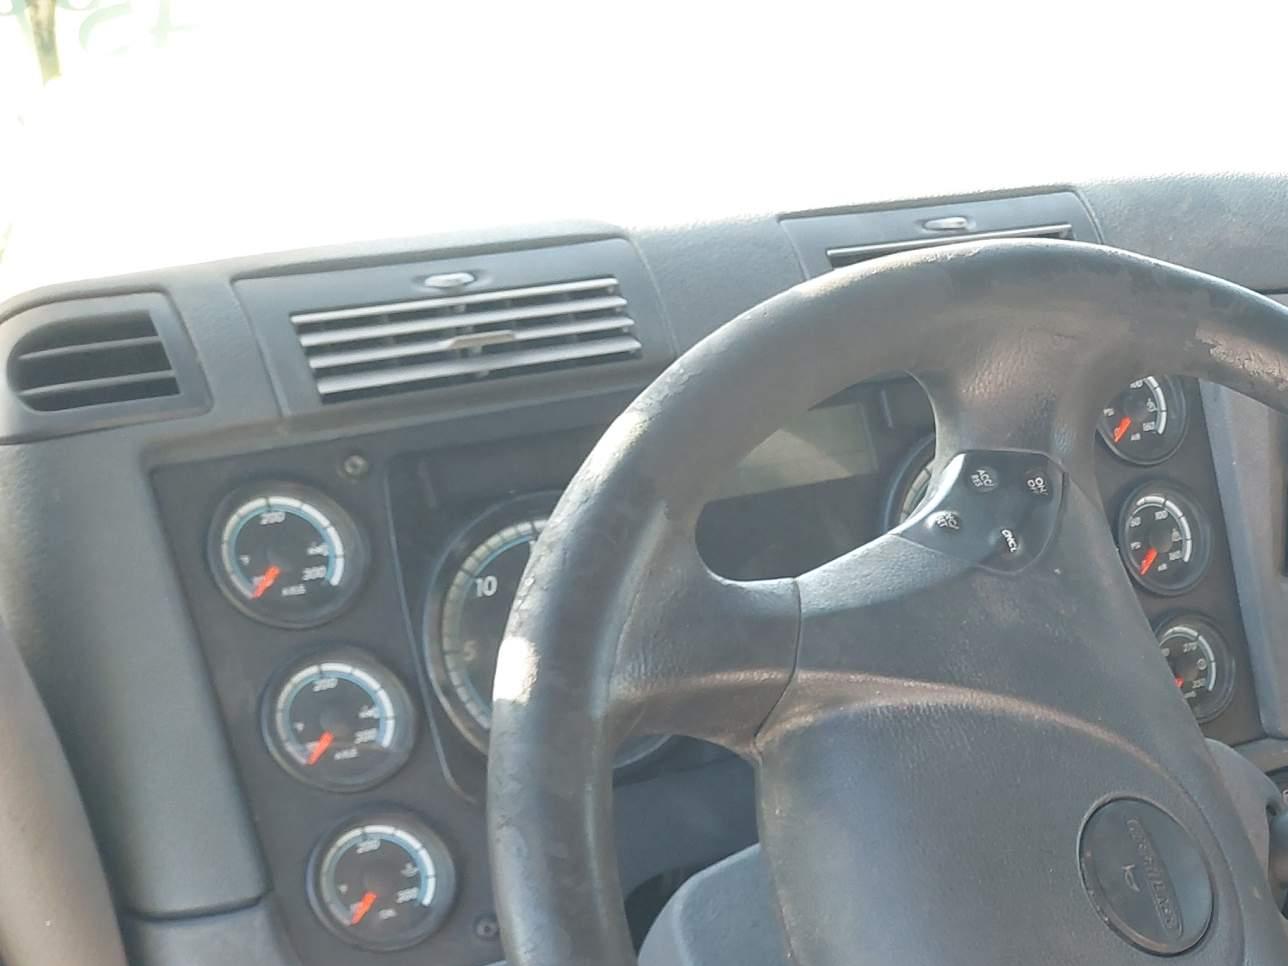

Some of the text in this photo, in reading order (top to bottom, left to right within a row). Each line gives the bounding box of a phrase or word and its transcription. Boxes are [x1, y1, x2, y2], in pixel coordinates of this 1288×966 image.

[1001, 529, 1017, 553] CNCL
[475, 575, 498, 597] 10
[463, 640, 477, 662] 5
